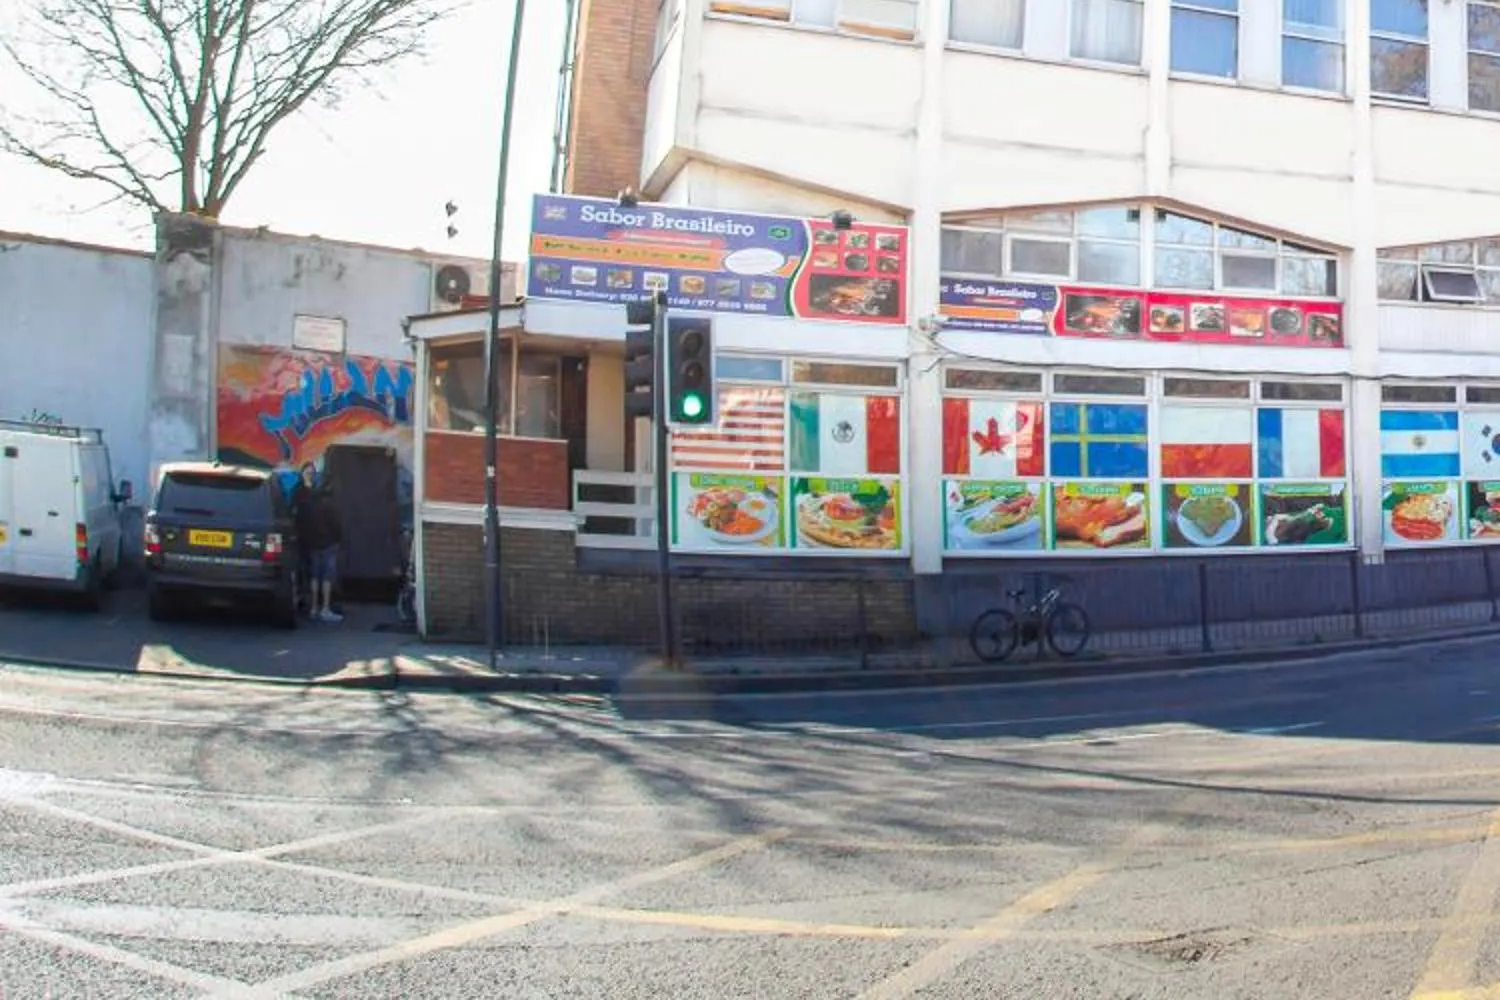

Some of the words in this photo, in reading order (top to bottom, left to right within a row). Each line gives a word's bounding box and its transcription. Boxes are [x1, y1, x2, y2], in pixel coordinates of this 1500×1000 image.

[580, 205, 647, 228] Sabor
[651, 211, 755, 237] Brasileiro
[953, 284, 986, 296] Sabor
